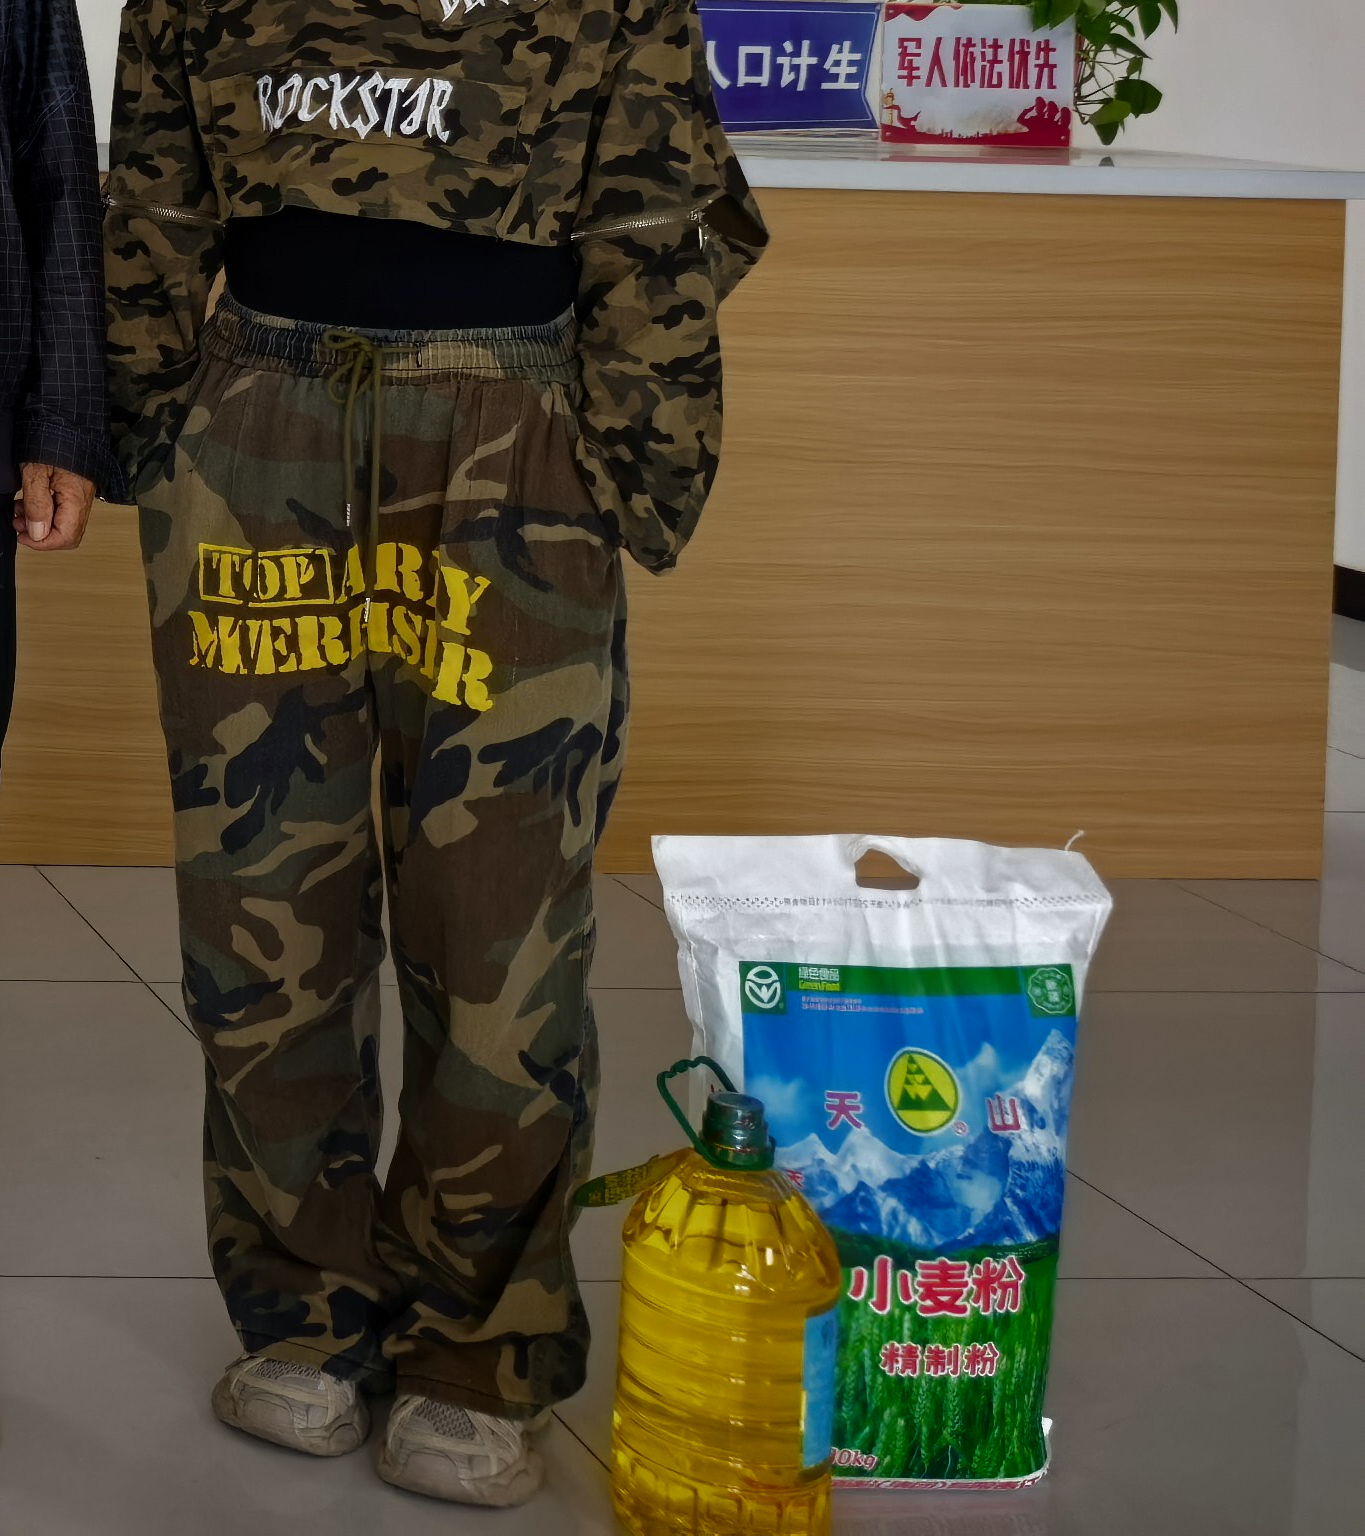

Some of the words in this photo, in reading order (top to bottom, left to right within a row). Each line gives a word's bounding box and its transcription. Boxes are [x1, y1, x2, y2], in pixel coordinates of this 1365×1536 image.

[896, 36, 1058, 90] 军人依法优先
[256, 72, 453, 143] ROCKSTAR
[211, 552, 316, 600] TOP
[825, 1090, 862, 1130] 天
[986, 1093, 1022, 1133] 山
[847, 1256, 1026, 1317] 小麦粉
[879, 1341, 1000, 1377] 精制粉
